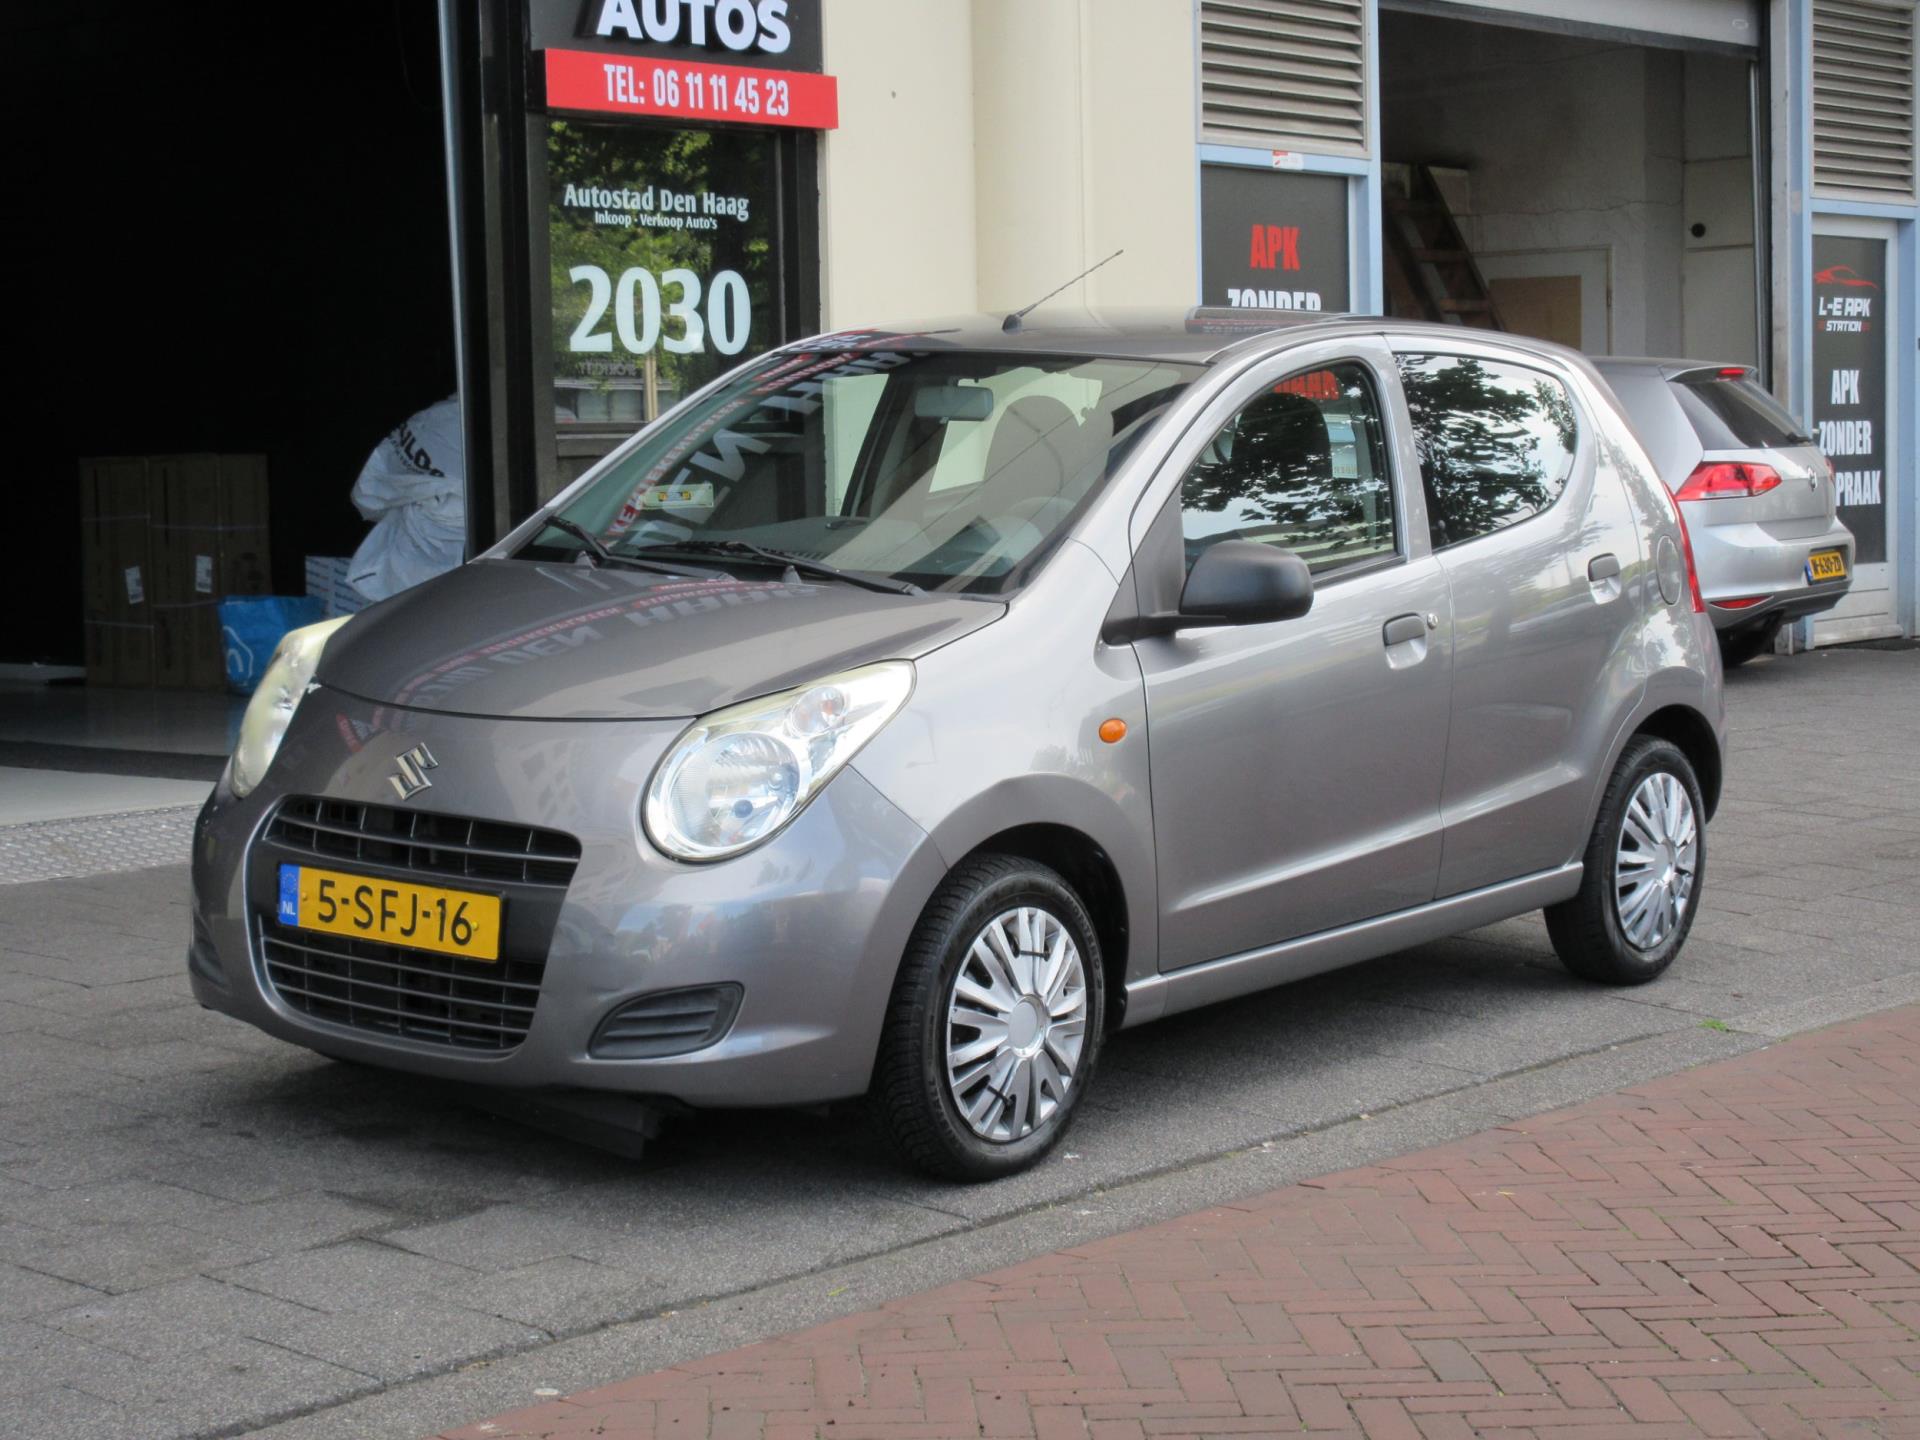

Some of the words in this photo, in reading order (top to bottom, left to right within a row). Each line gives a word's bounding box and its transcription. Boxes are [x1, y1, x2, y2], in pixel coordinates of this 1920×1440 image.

[596, 0, 792, 53] AUTOS
[603, 64, 645, 104] TEL:
[653, 68, 679, 107] 06
[685, 72, 704, 109] 11
[709, 74, 728, 111] 11
[734, 77, 760, 114] 45
[765, 79, 790, 116] 23
[563, 184, 654, 211] Autostad
[660, 189, 697, 213] Den
[702, 192, 750, 222] Haag
[595, 210, 632, 228] Inkoop
[640, 213, 684, 230] Verkoop
[685, 217, 718, 230] Auto's
[1250, 224, 1300, 271] APK
[568, 265, 751, 356] 2030
[1844, 297, 1871, 317] APK
[1825, 320, 1862, 333] STATION
[1831, 369, 1860, 405] APK
[1819, 420, 1872, 456] ZONDER
[281, 900, 296, 916] NL
[317, 878, 473, 946] 5-SFJ-16
